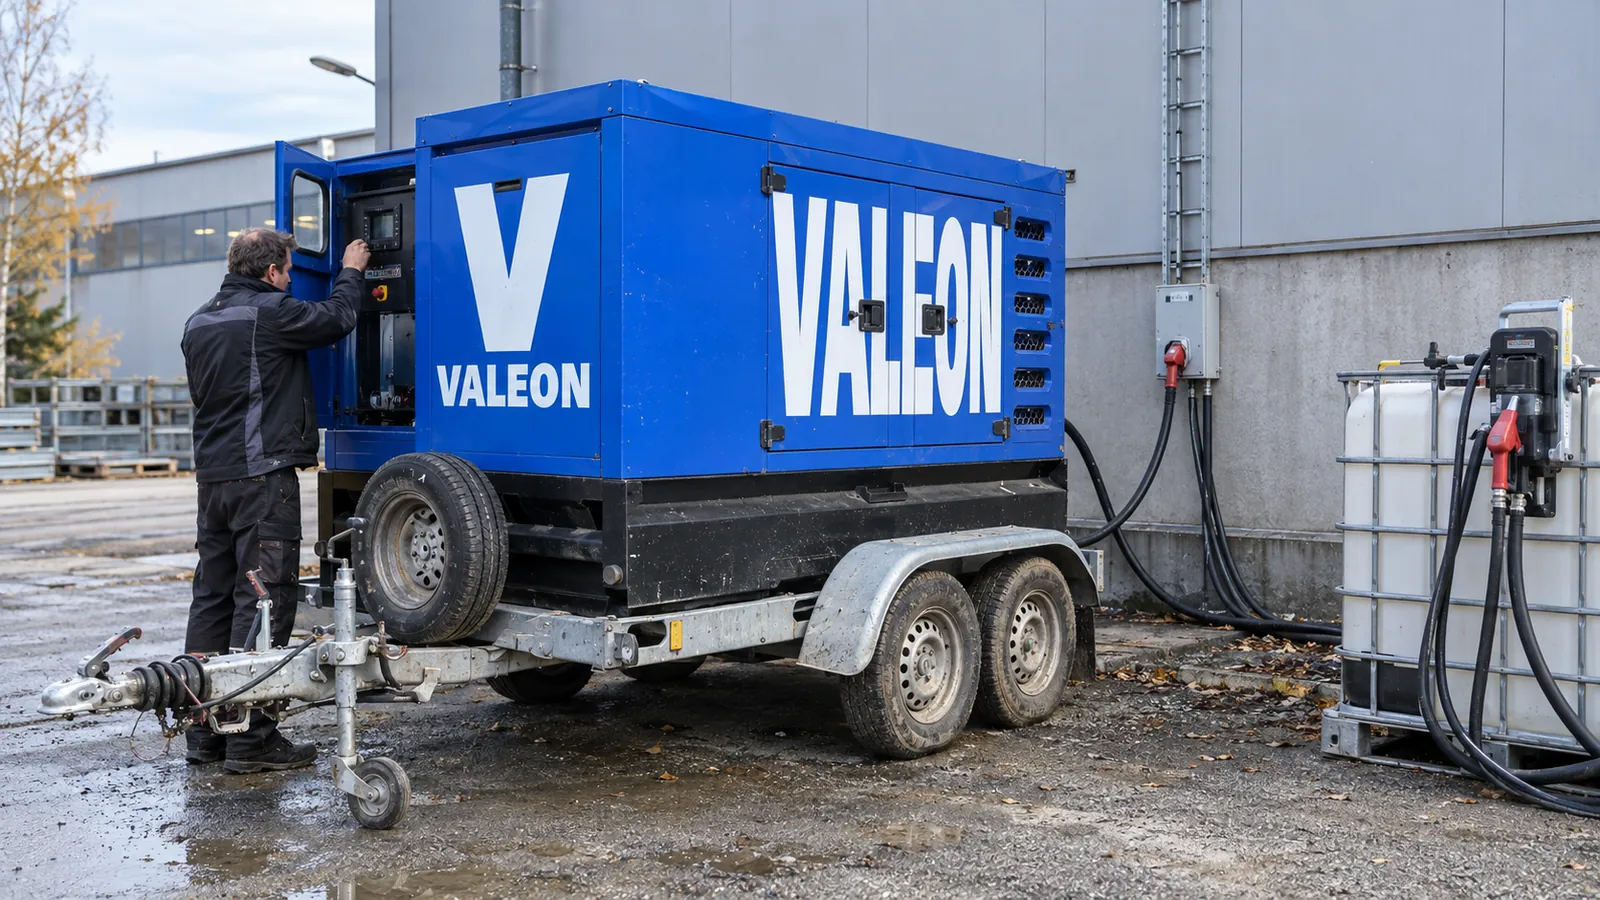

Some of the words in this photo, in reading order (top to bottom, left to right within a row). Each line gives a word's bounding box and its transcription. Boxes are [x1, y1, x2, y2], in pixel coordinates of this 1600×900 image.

[454, 173, 570, 352] V
[772, 191, 1003, 416] VALEON
[436, 362, 590, 409] VALEON
